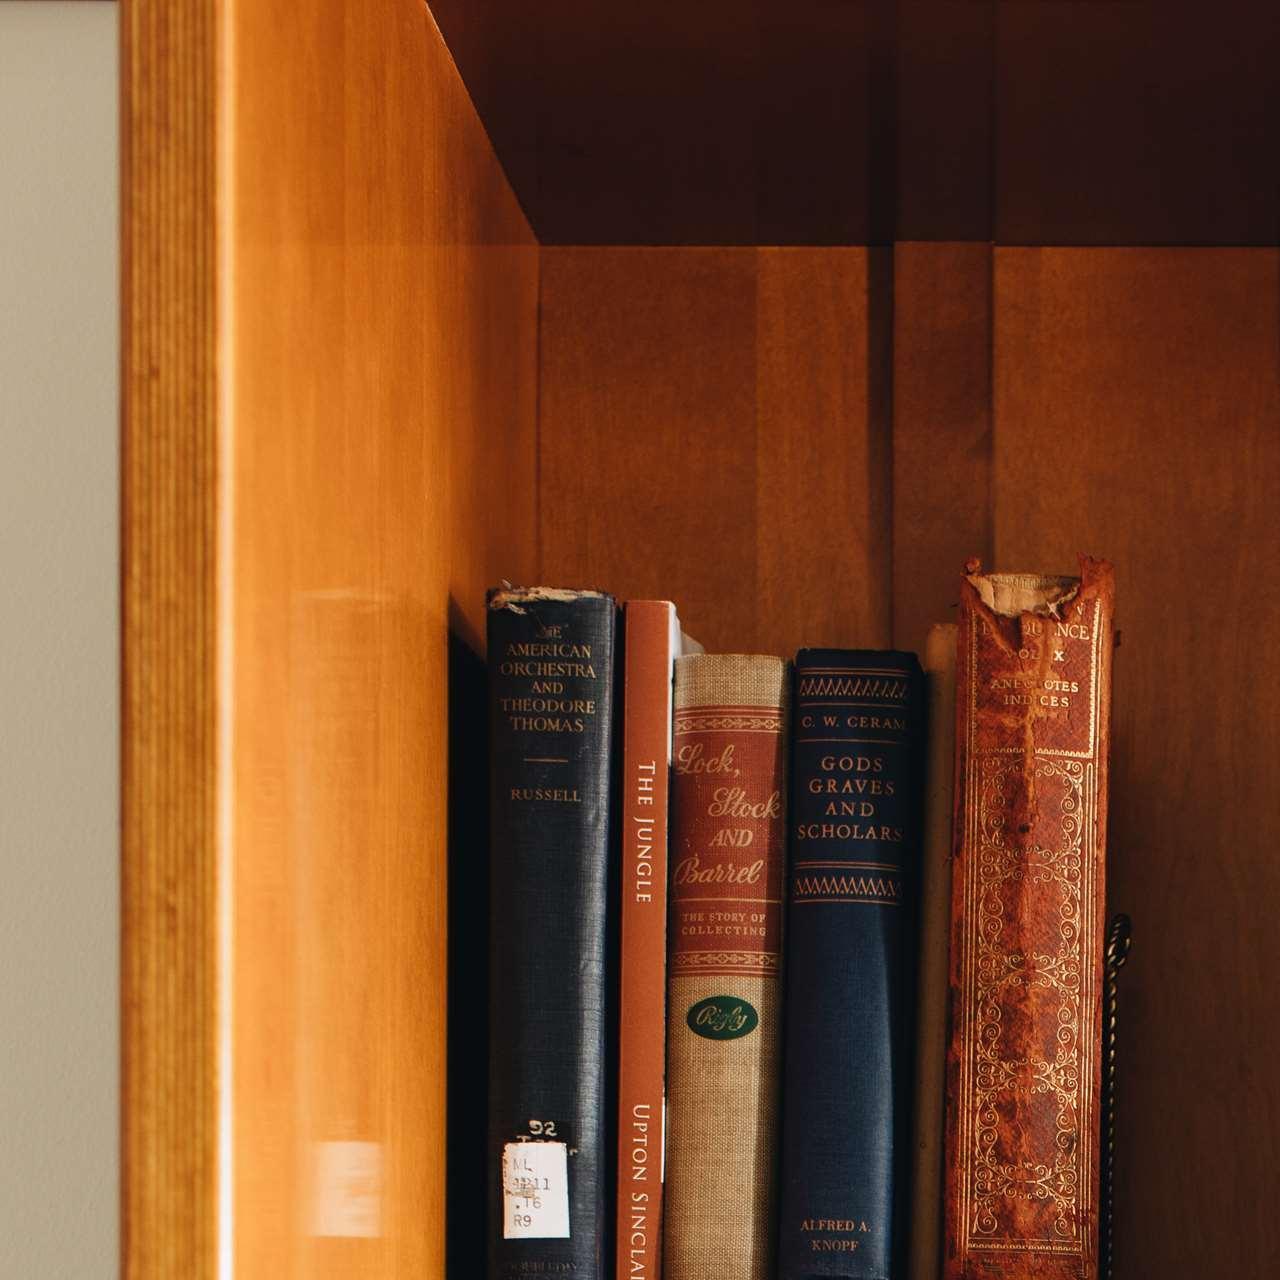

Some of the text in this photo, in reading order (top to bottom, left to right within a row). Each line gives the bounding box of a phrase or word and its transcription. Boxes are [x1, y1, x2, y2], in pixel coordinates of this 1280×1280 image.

[506, 643, 592, 659] AMERICAN
[500, 662, 597, 679] ORCHESTRA
[532, 681, 564, 694] AND
[991, 679, 1080, 694] ANECOTES
[502, 698, 596, 715] THEODORE
[1004, 695, 1070, 707] INDCES
[511, 716, 585, 732] THOMAS
[801, 715, 906, 730] C. W. CERAM
[675, 744, 741, 777] Lock,
[821, 756, 883, 772] GODS
[511, 787, 582, 803] RUSSELL
[808, 779, 896, 795] GRAVES
[707, 787, 780, 819] Stock
[825, 801, 875, 818] AND
[632, 760, 656, 904] THE JUNGLE
[708, 829, 754, 847] AND
[797, 823, 903, 842] SCHOLARS
[672, 857, 764, 885] Barrel
[682, 912, 767, 923] THE STORY OF
[681, 926, 767, 937] COLLECTING
[695, 1004, 748, 1032] Rigby
[527, 1119, 558, 1137] 92
[632, 1103, 650, 1181] UPTON
[513, 1214, 532, 1228] R9
[800, 1219, 872, 1233] ALFRED A.
[811, 1239, 859, 1252] KNOPF
